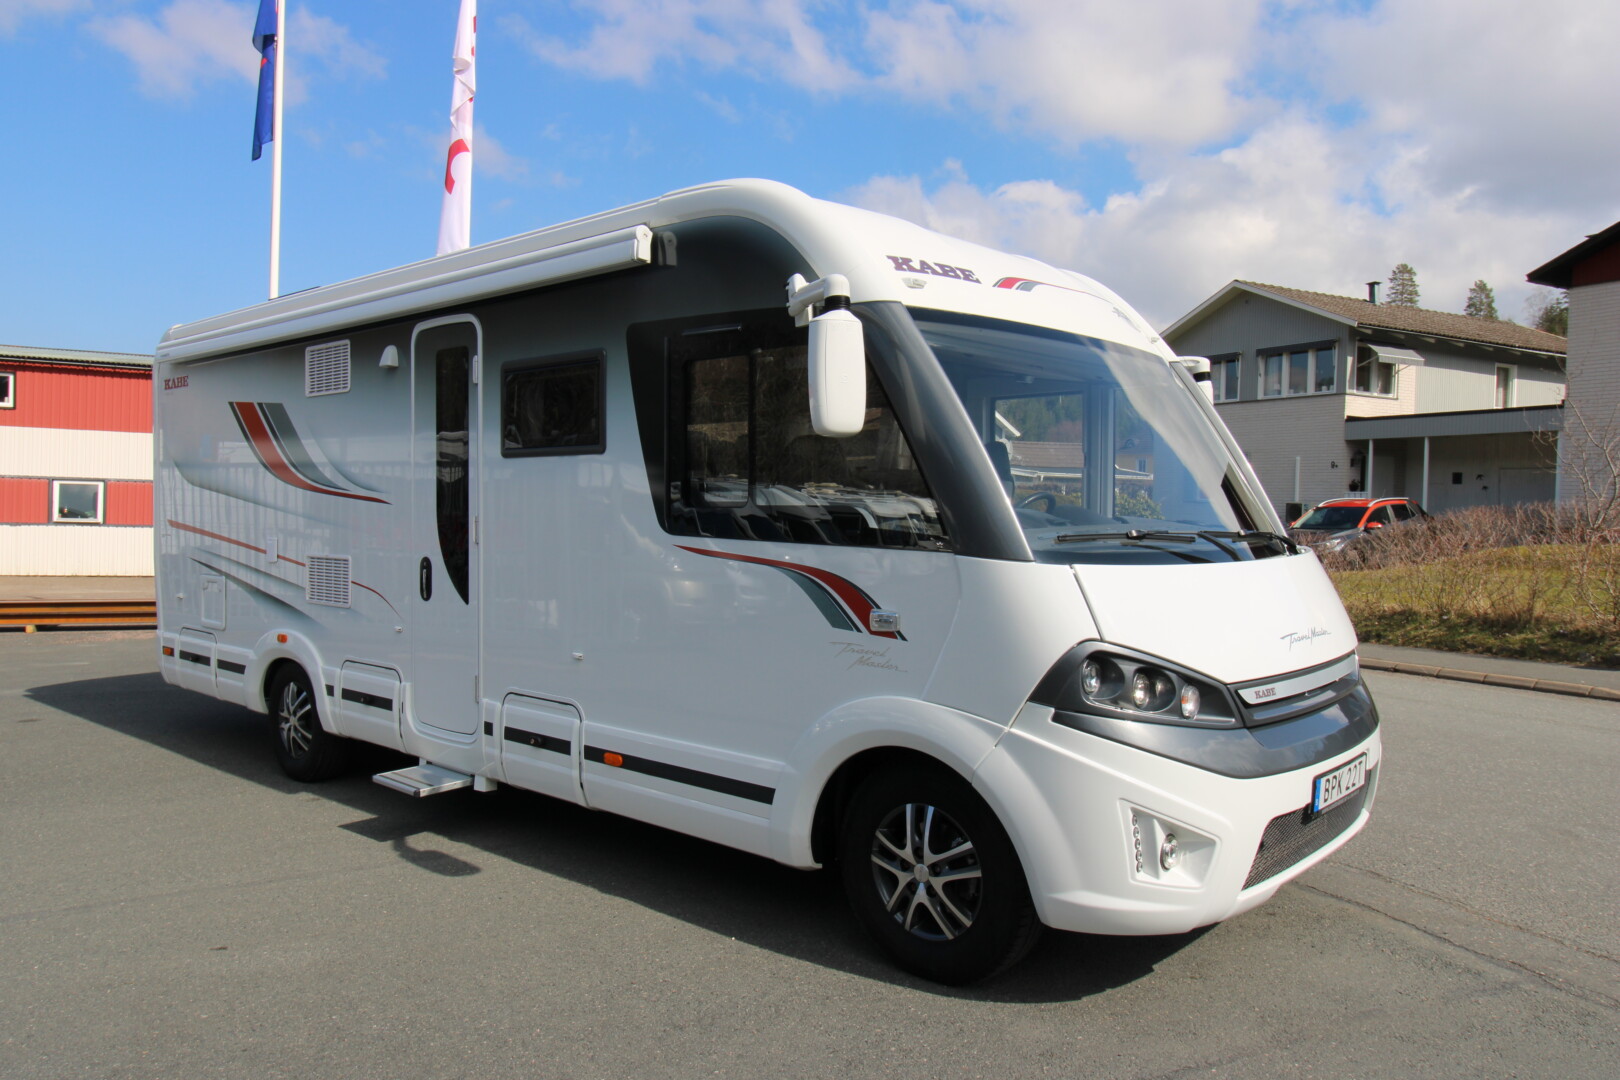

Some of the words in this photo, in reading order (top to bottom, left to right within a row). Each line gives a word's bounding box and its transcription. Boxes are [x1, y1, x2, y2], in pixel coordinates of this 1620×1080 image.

[886, 255, 982, 284] KABE
[164, 375, 189, 390] KABE
[1280, 626, 1311, 652] Travel
[828, 641, 891, 658] Travel
[846, 655, 908, 672] Master
[1254, 687, 1276, 699] KABE
[1323, 770, 1344, 803] BPK
[1345, 760, 1363, 791] 22T
